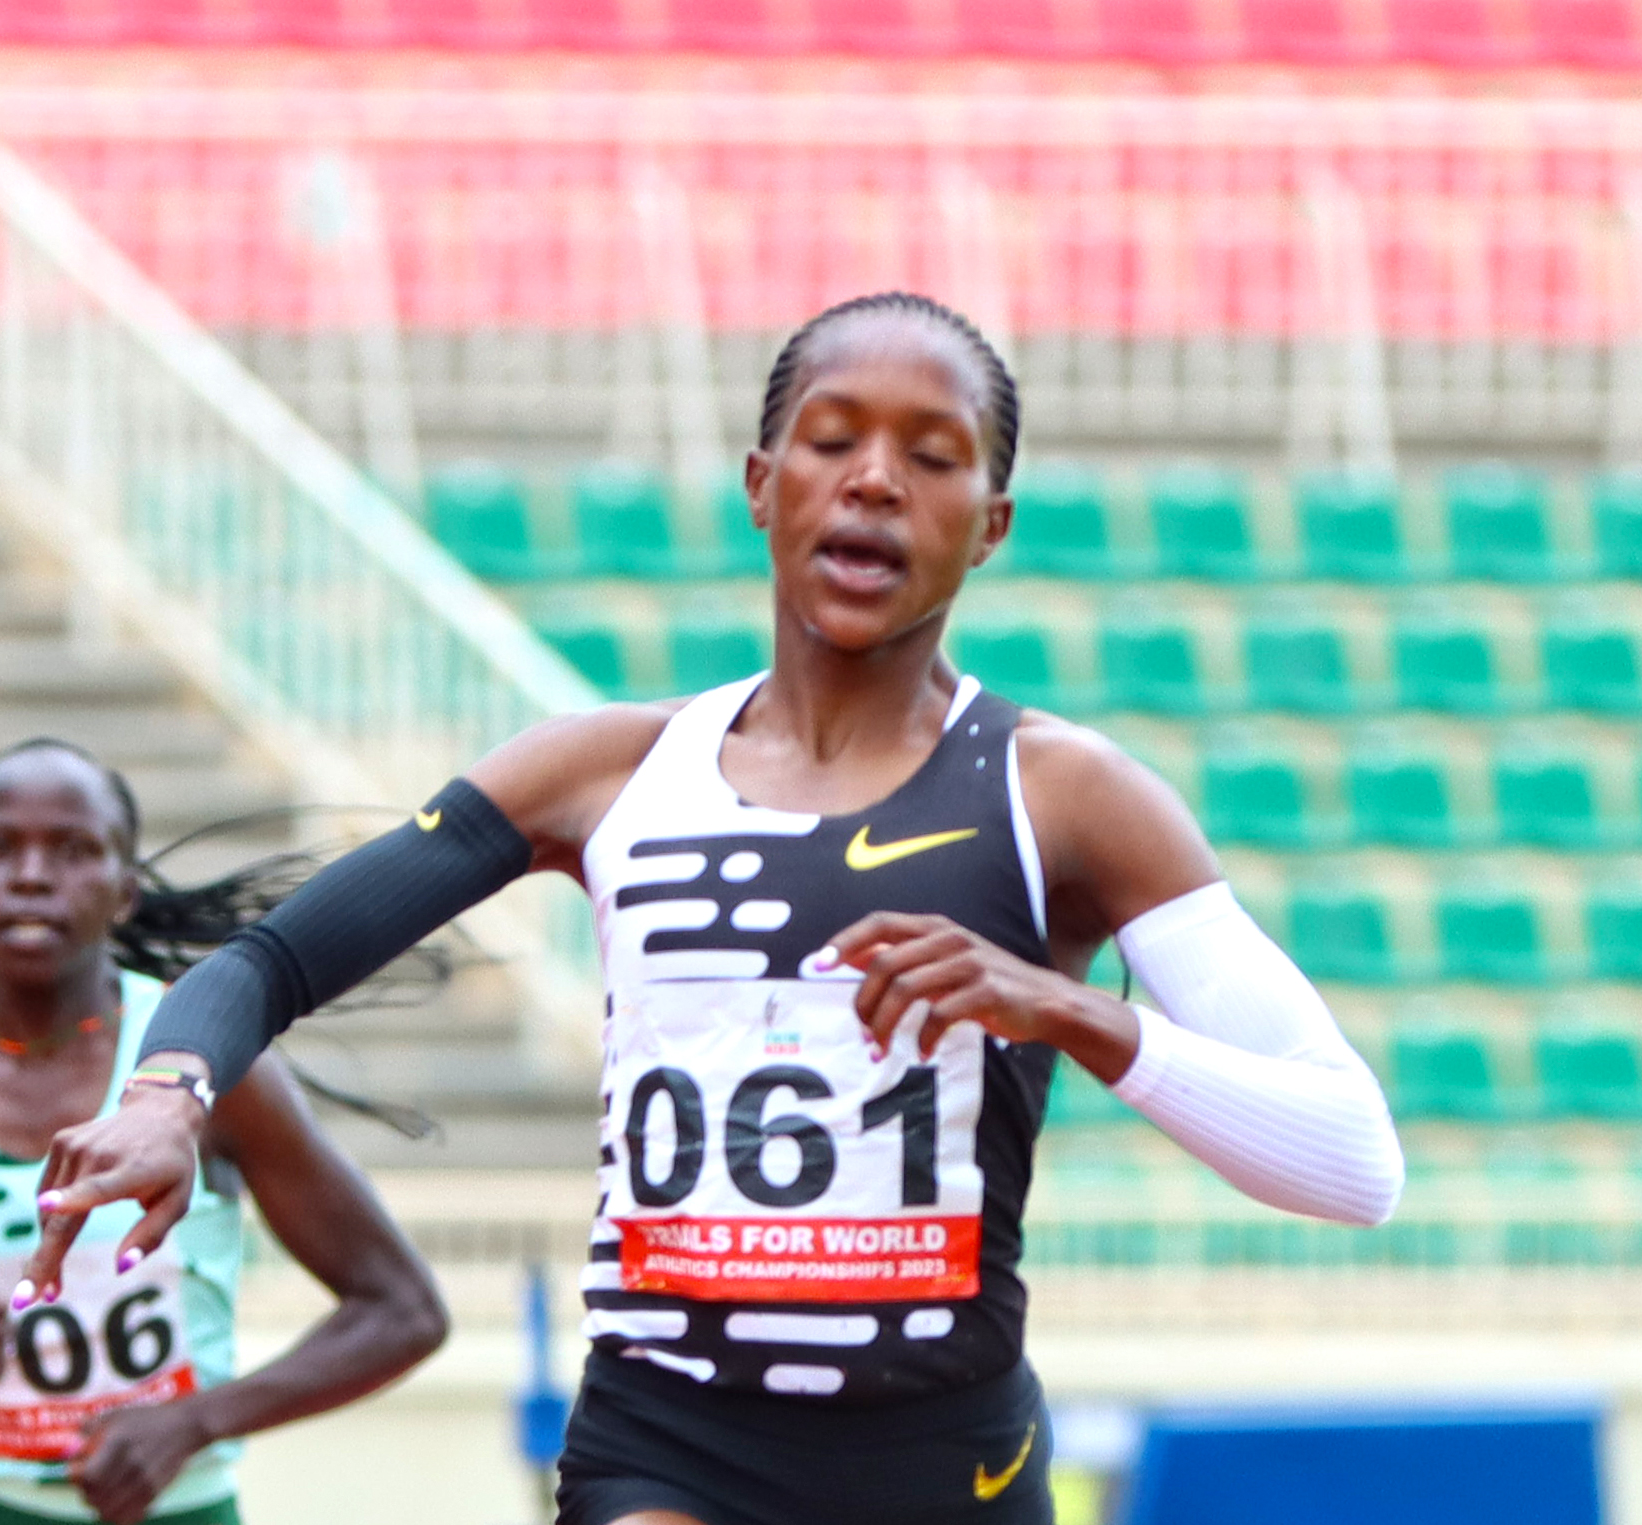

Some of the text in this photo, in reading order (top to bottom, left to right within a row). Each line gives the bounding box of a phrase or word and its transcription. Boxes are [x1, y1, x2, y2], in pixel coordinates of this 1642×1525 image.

[626, 1064, 938, 1208] 061
[741, 1225, 815, 1254] FOR
[822, 1223, 947, 1254] WORLD
[722, 1260, 896, 1281] CHAMPIONSHIPS
[898, 1257, 947, 1279] 2023
